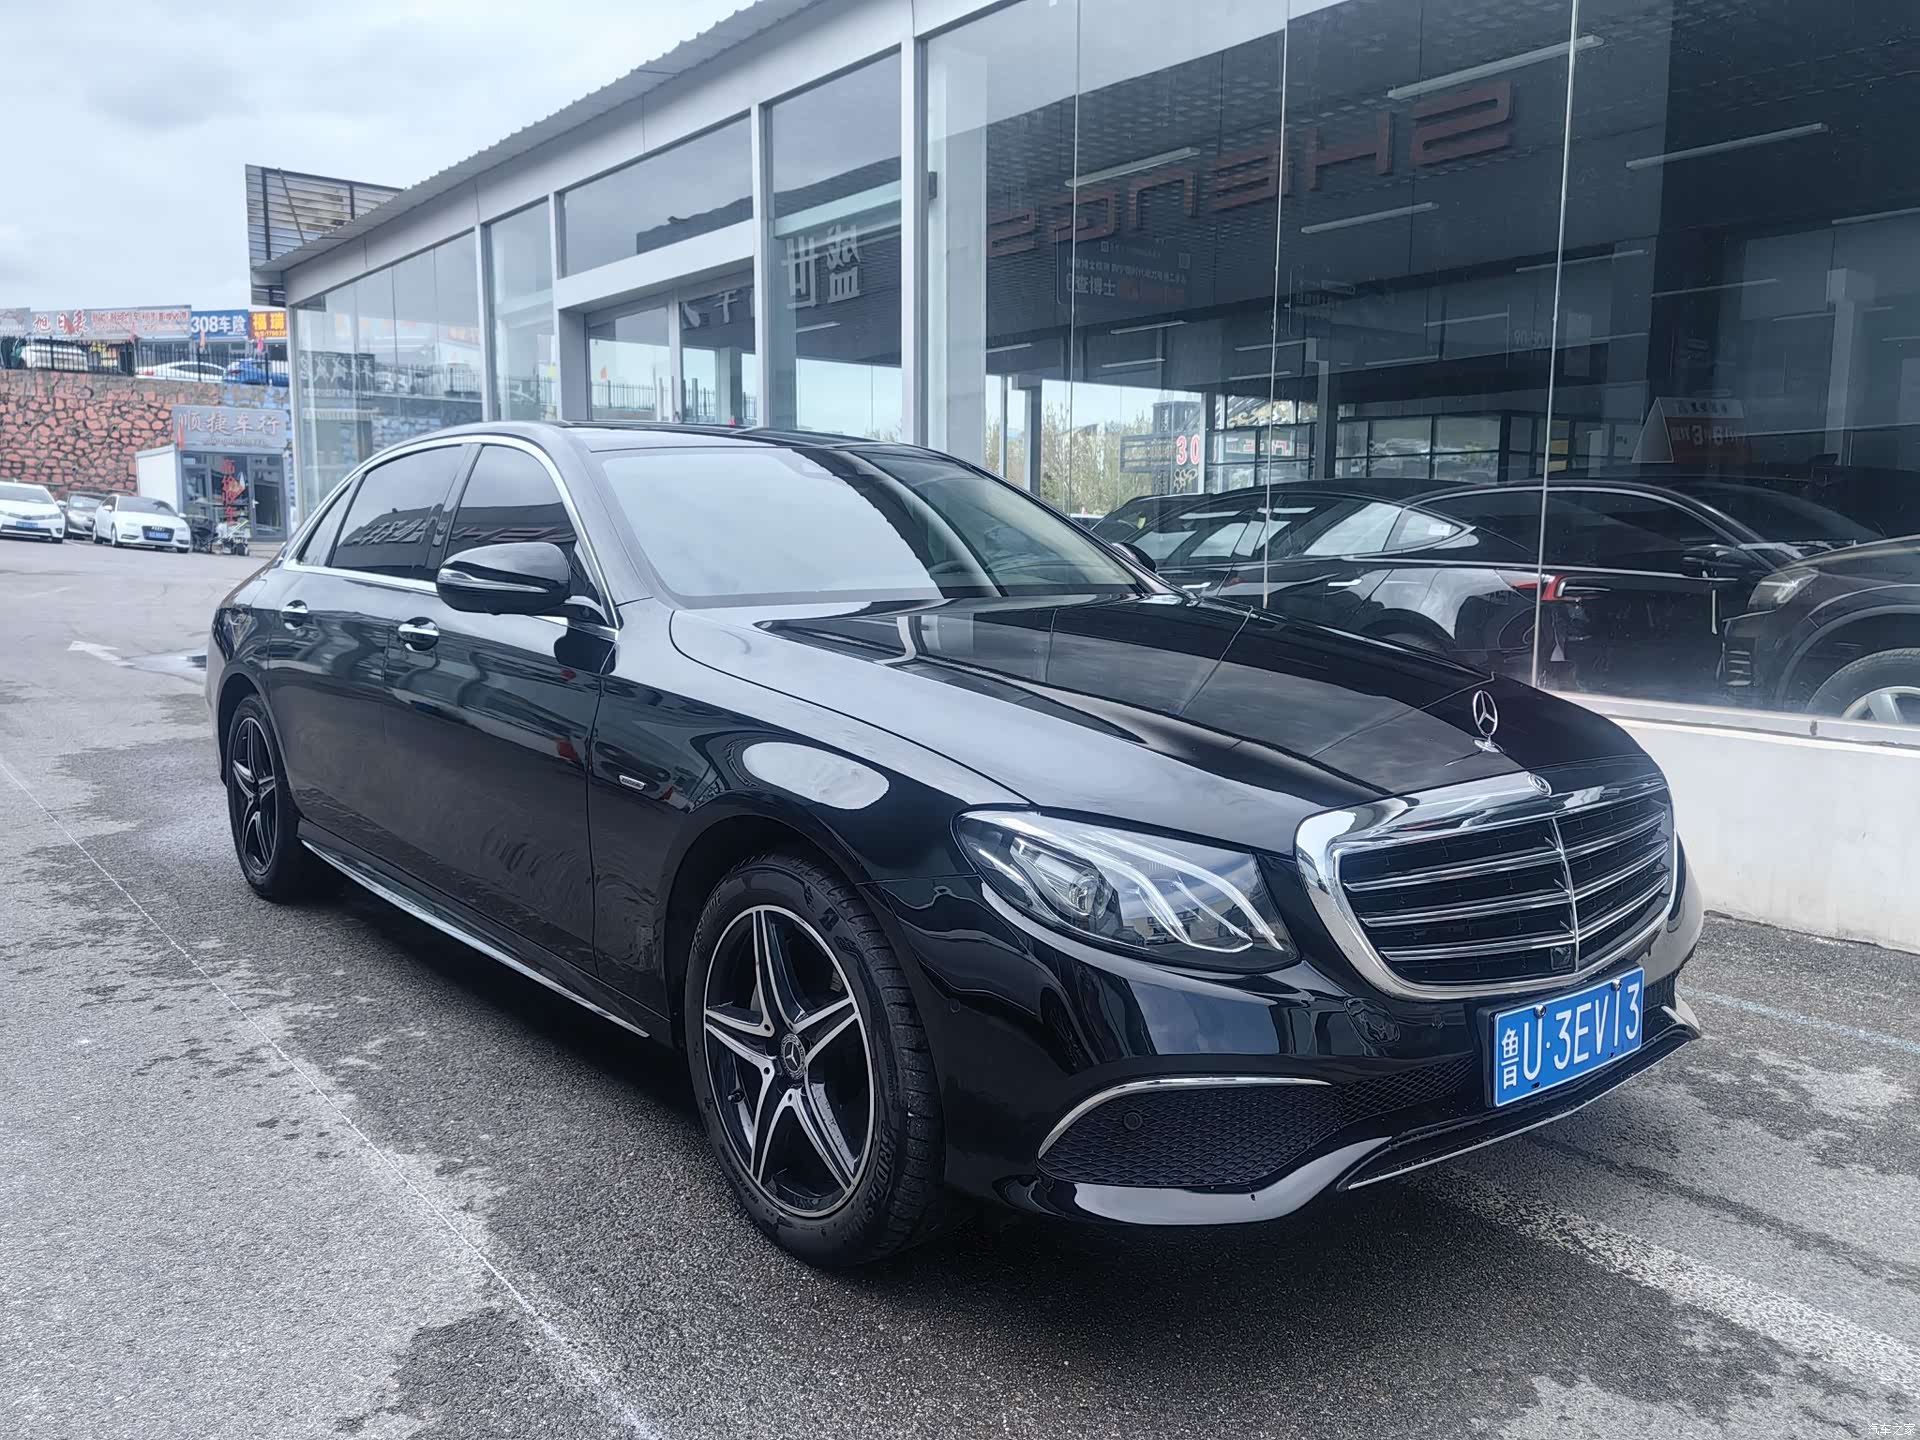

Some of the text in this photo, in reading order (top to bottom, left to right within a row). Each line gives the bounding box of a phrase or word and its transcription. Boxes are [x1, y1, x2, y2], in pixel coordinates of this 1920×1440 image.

[191, 314, 246, 334] 308车险
[178, 410, 279, 436] 顺捷车行
